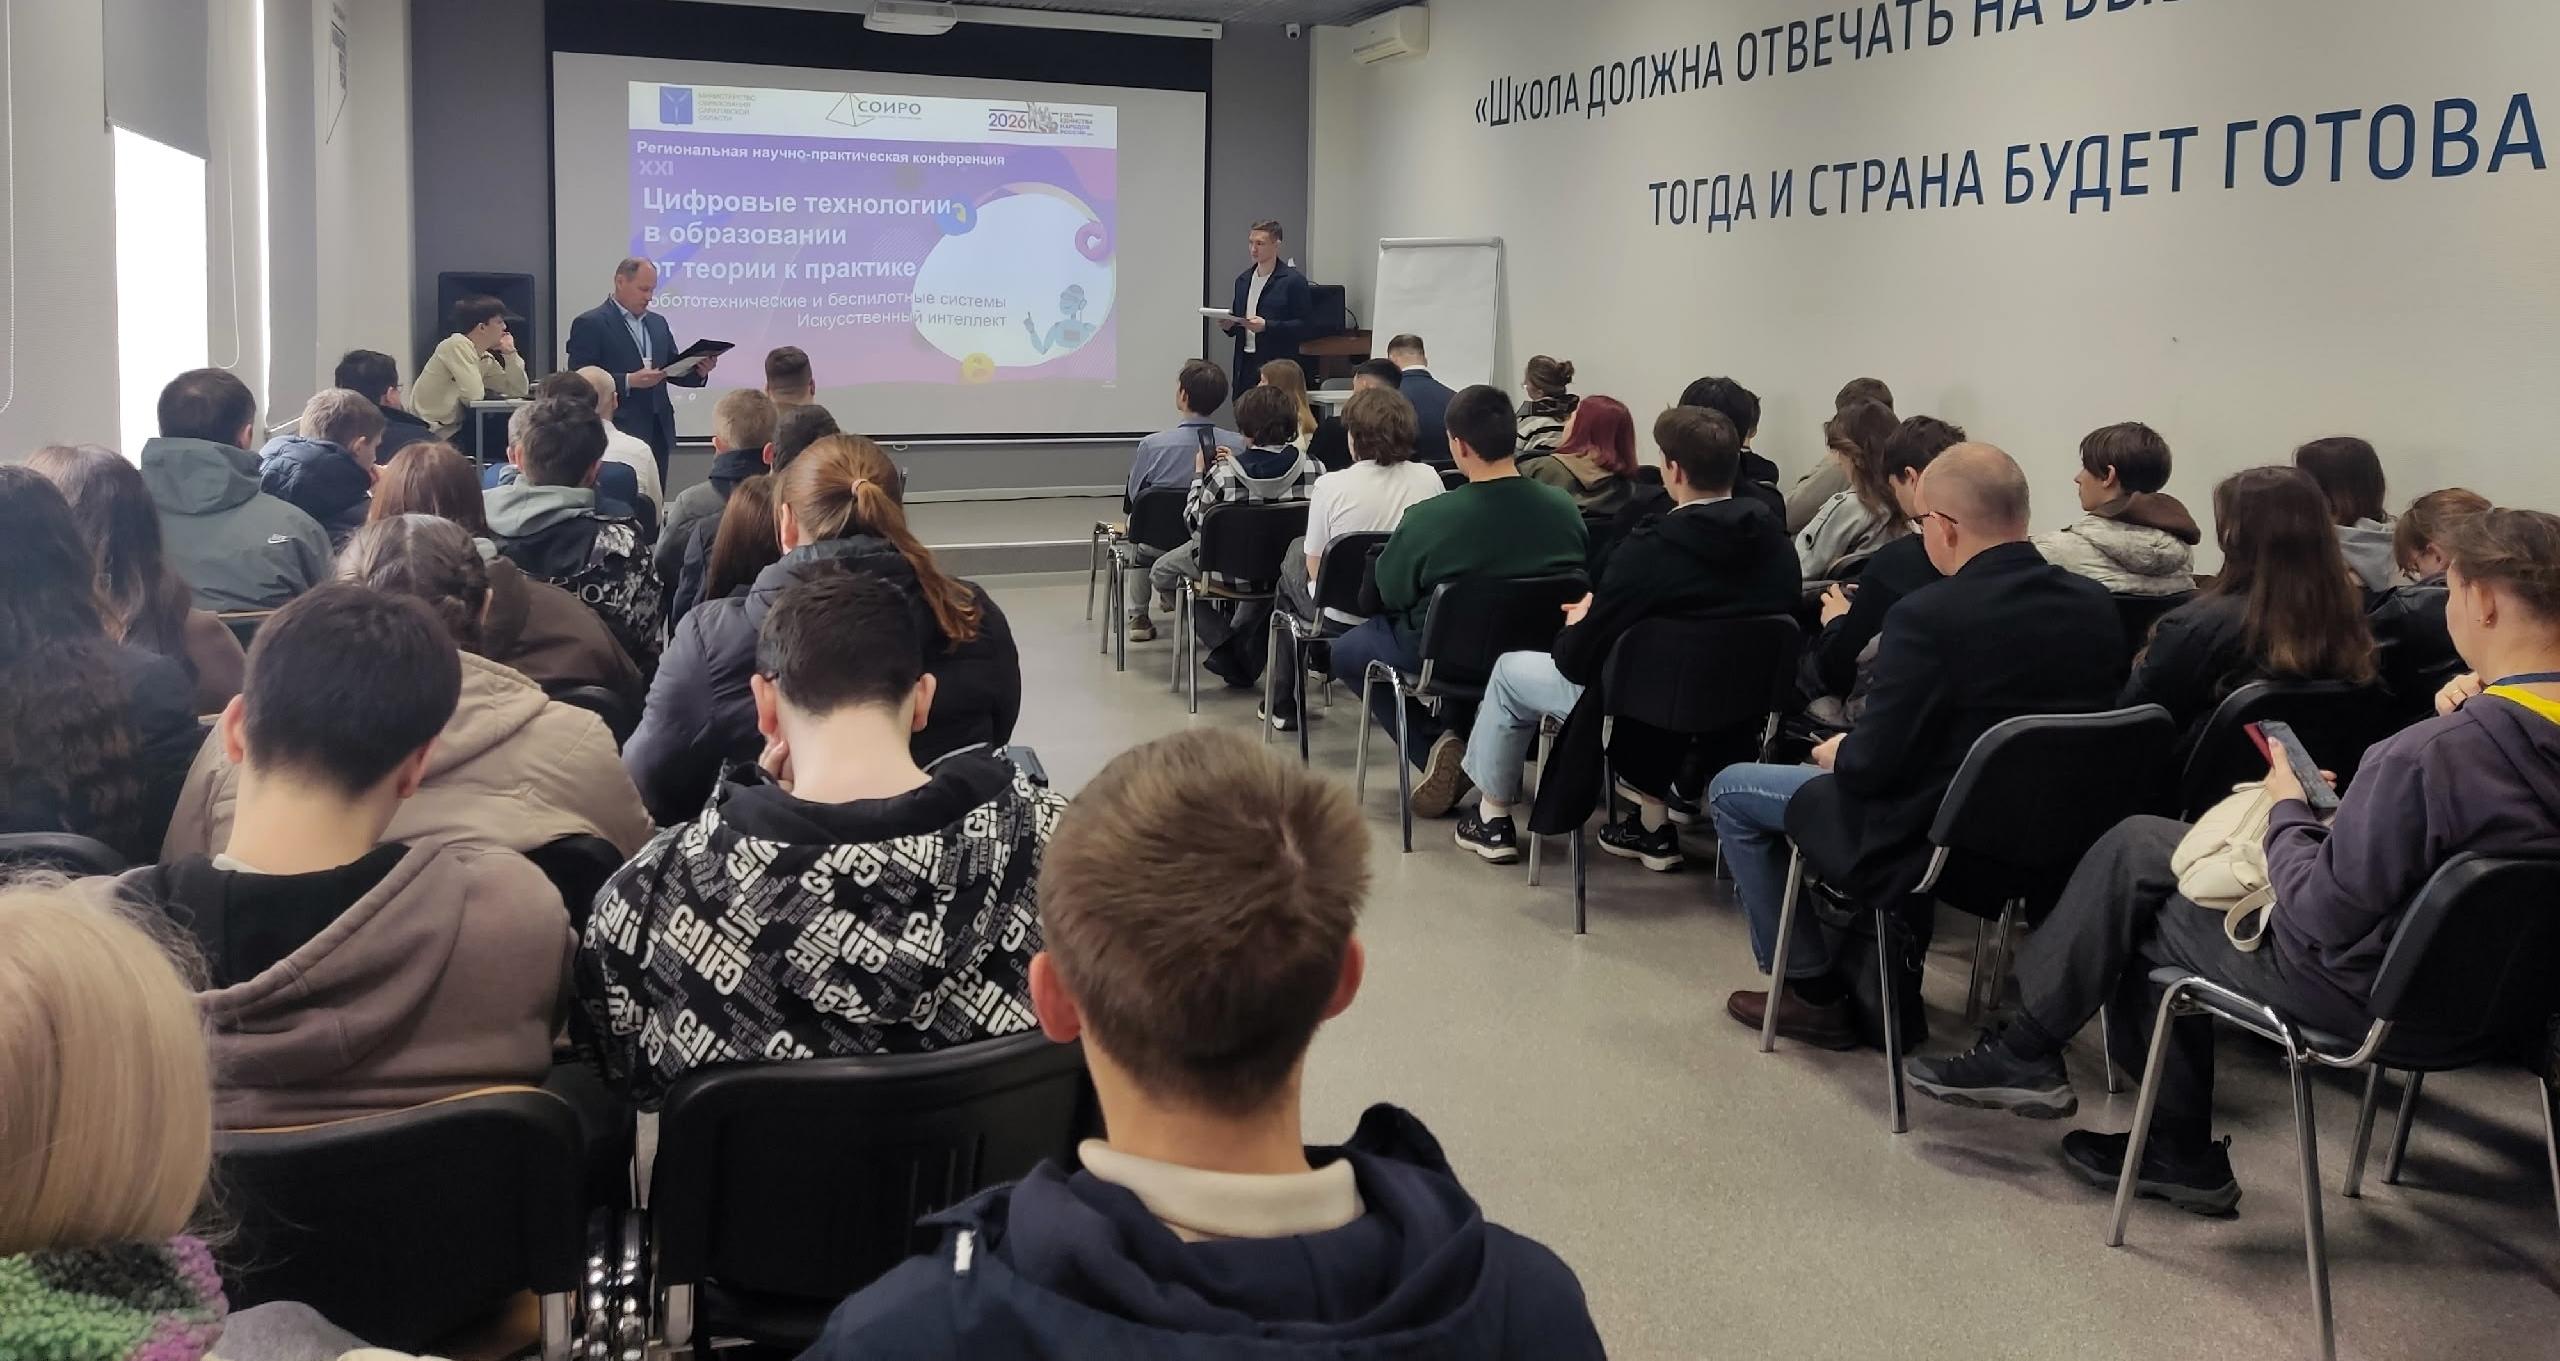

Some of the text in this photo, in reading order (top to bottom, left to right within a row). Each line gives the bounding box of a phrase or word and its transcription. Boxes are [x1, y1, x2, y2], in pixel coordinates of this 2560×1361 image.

[1474, 75, 1580, 128] «ШКОЛА
[1587, 40, 1724, 120] ДОЛЖНА
[1737, 0, 1954, 82] ОТВЕЧАТЬ
[858, 100, 921, 115] СОИРО
[988, 112, 1027, 129] 2026
[636, 141, 1005, 168] Региональная научно-практическая конференция
[1648, 92, 2547, 234] ТОГДА И СТРАНА БУДЕТ ГОТОВА
[643, 187, 951, 215] Цифровые технологии
[644, 220, 847, 249] в образовании
[682, 261, 776, 284] теории
[784, 261, 798, 280] к
[805, 258, 917, 284] практике
[650, 291, 1007, 310] обототехнические и беспилотные системы
[797, 310, 1008, 331] Искусственный интеллект
